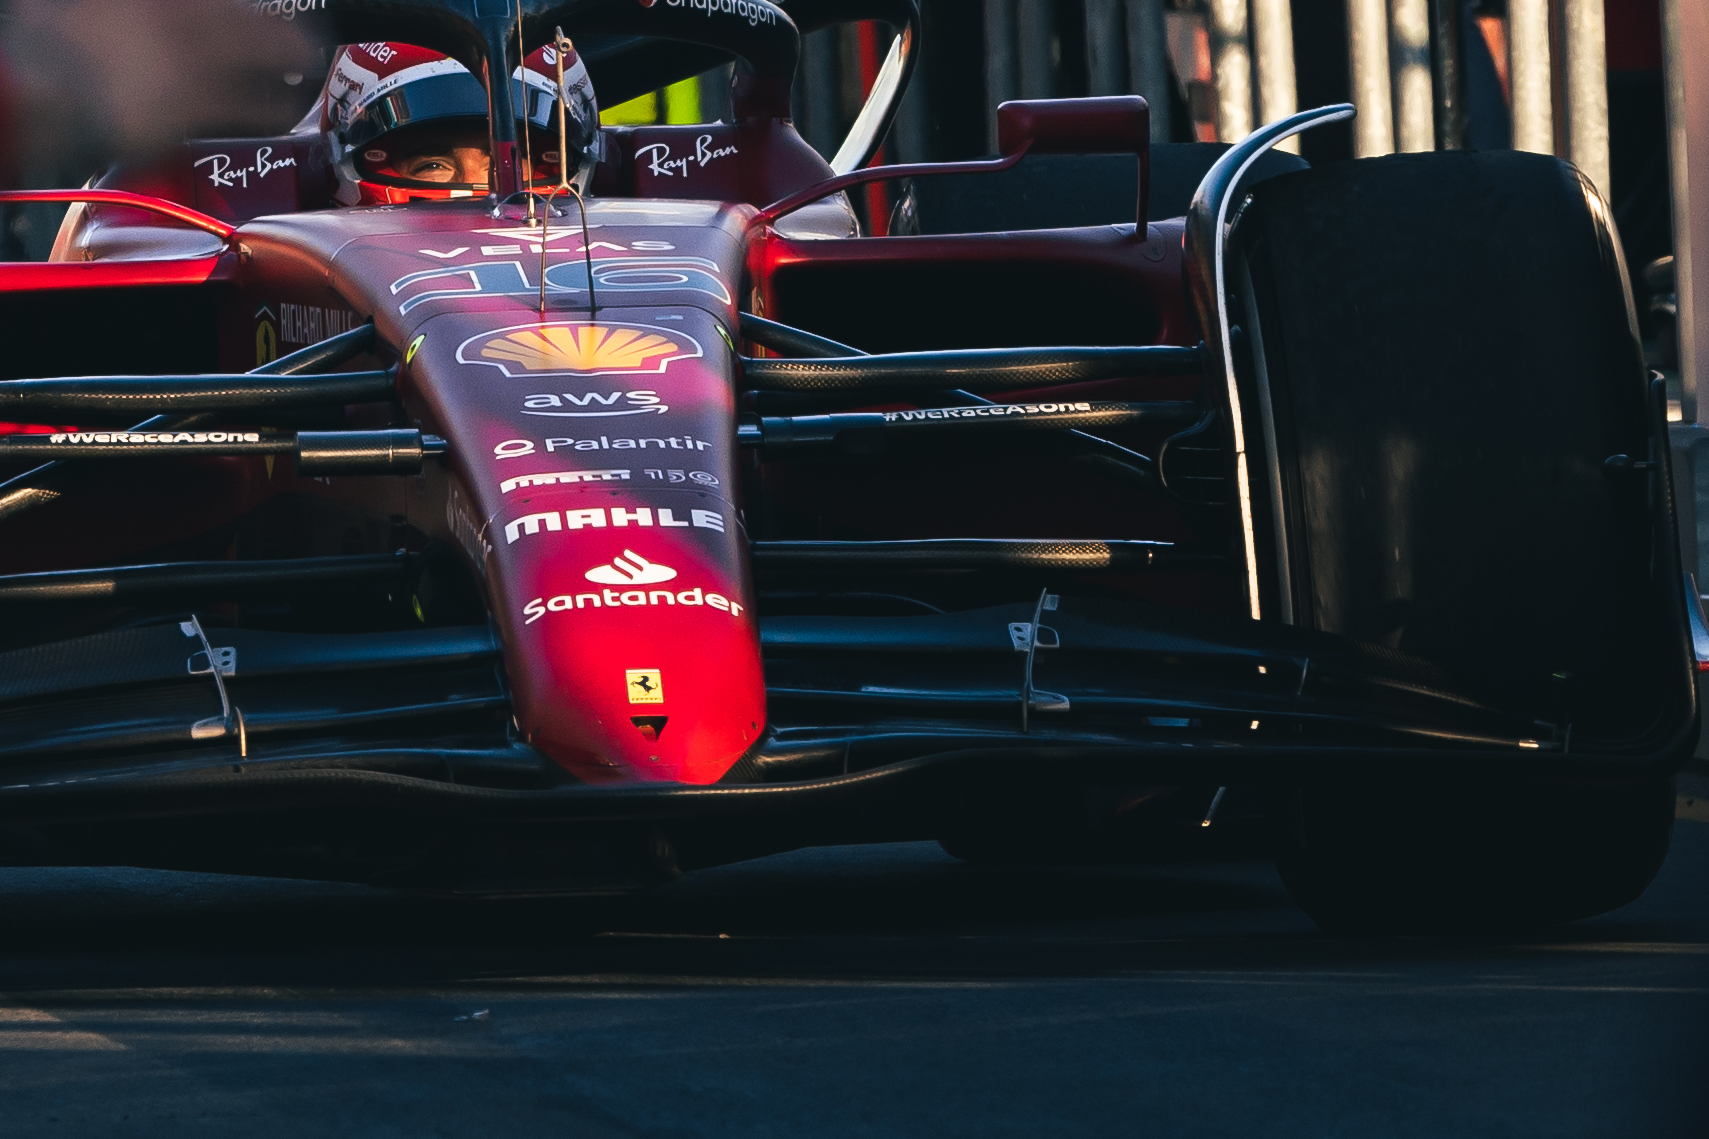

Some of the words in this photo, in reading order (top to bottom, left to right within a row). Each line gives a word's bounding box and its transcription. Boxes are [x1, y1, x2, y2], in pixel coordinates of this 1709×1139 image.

[194, 146, 298, 188] Ray-Ban
[634, 134, 739, 178] Ray-Ban
[419, 240, 676, 259] VELAS
[391, 256, 732, 317] 16
[523, 390, 662, 409] aws
[49, 431, 260, 444] #WeRaceAsOne
[545, 435, 713, 452] Palantir
[504, 507, 725, 545] MAHLE
[523, 587, 744, 626] Santander
